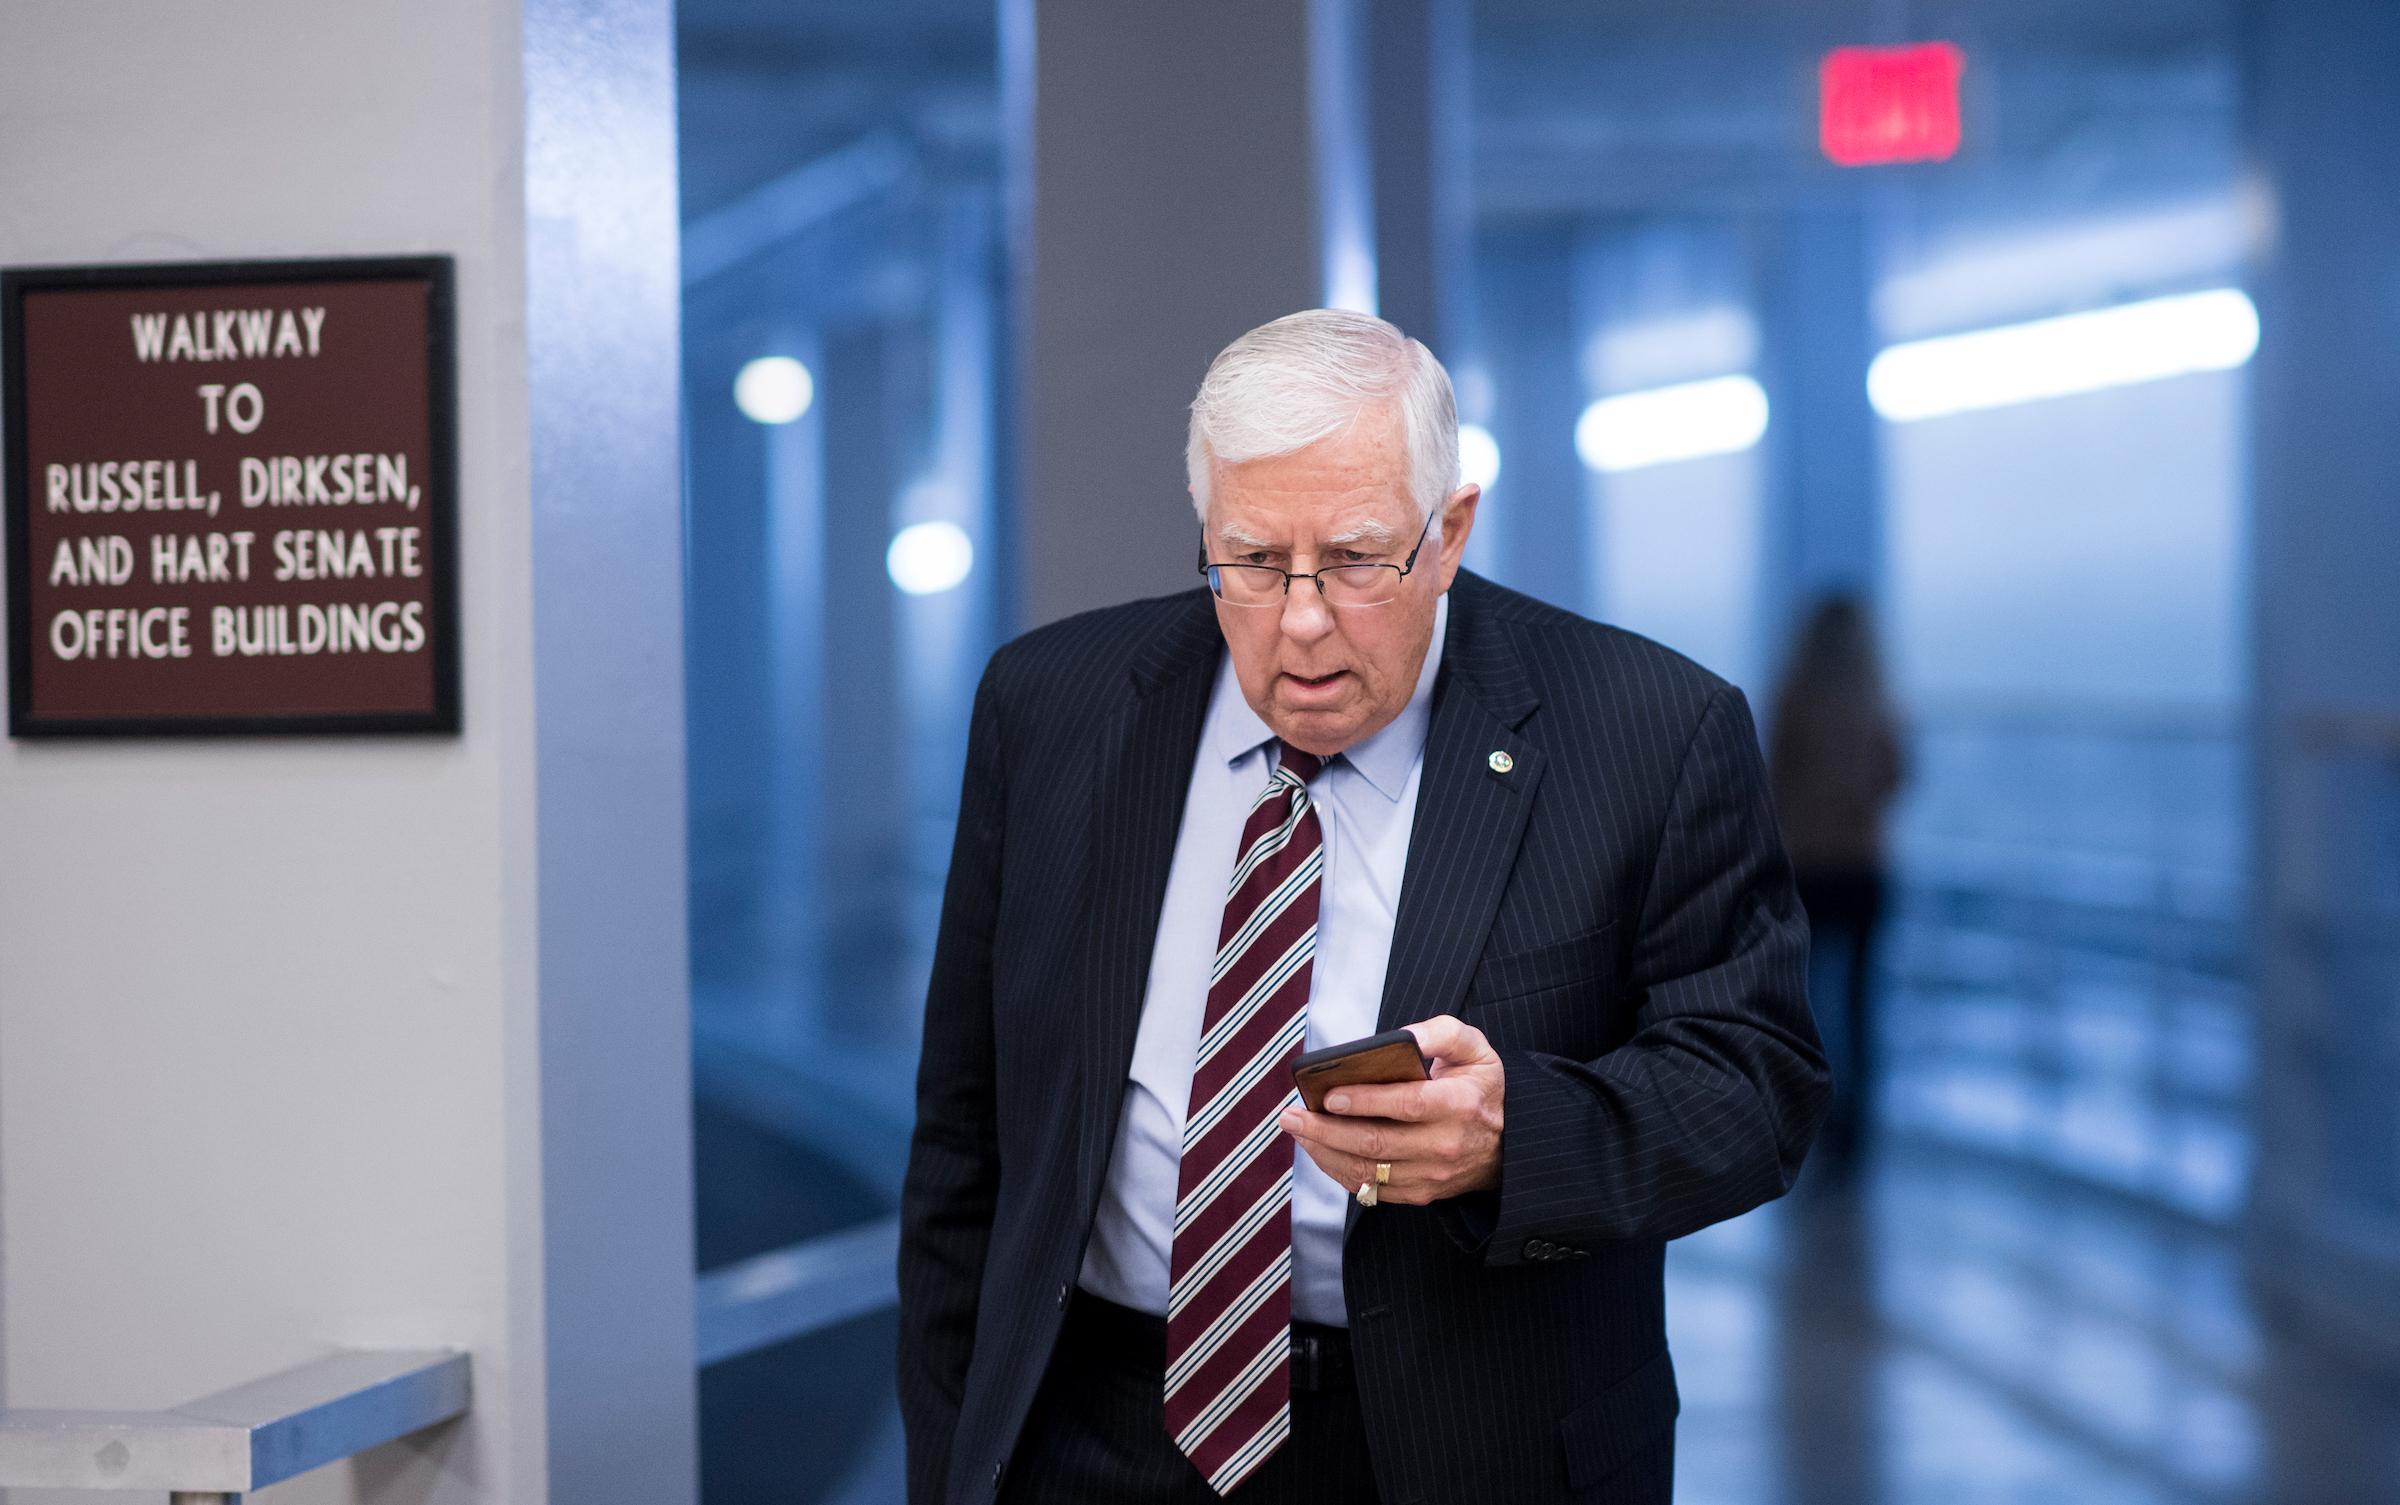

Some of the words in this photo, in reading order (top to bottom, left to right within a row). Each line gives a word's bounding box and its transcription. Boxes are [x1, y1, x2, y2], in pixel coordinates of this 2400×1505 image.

[131, 307, 326, 362] WALKWAY
[198, 382, 265, 434] TO
[46, 459, 220, 517] RUSSELL,
[240, 453, 421, 511] DIRKSEN,
[50, 535, 135, 586] AND
[151, 531, 255, 583] HART
[273, 527, 423, 581] SENATE
[50, 606, 191, 661] OFFICE
[211, 600, 426, 657] BUILDINGS
